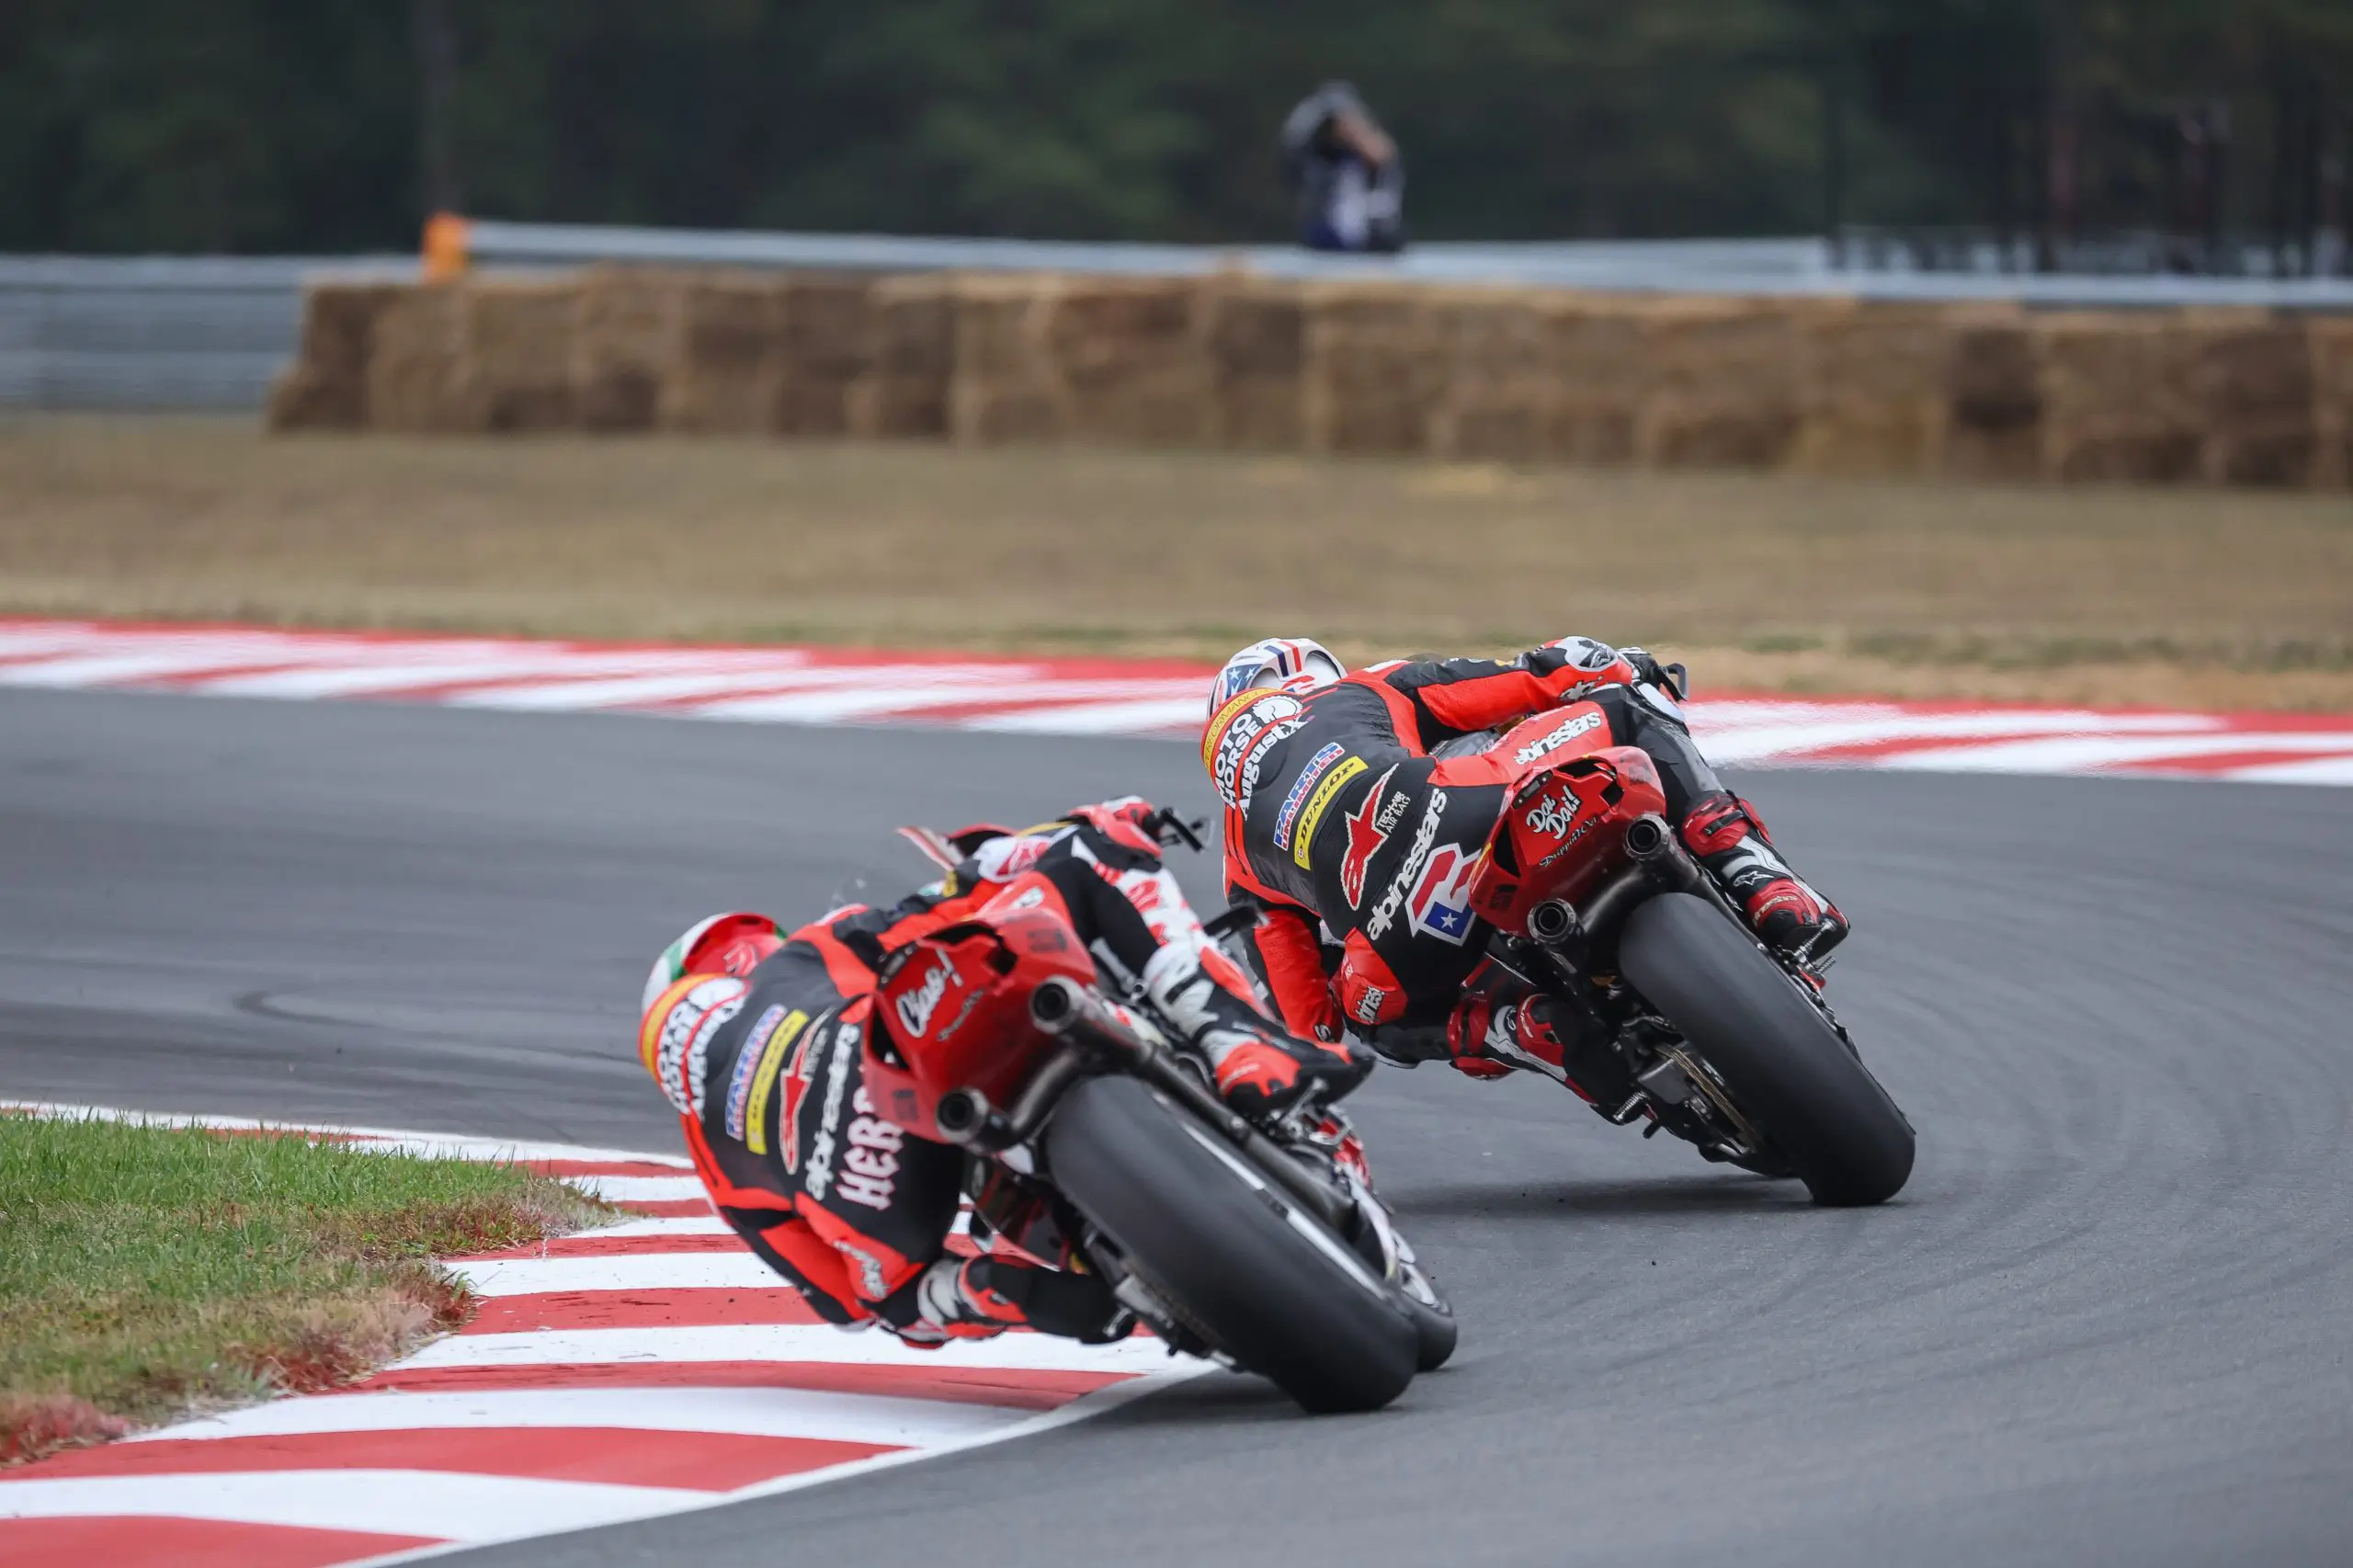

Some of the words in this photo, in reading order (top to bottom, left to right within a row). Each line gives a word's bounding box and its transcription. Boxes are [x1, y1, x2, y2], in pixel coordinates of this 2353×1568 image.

[1274, 742, 1341, 846] PARTS
[1281, 748, 1346, 851] UNLIMITED
[1301, 762, 1356, 841] DUNLOP
[1526, 794, 1556, 833] Dai
[1545, 785, 1582, 840] Dai!
[1367, 788, 1448, 941] alpinestars
